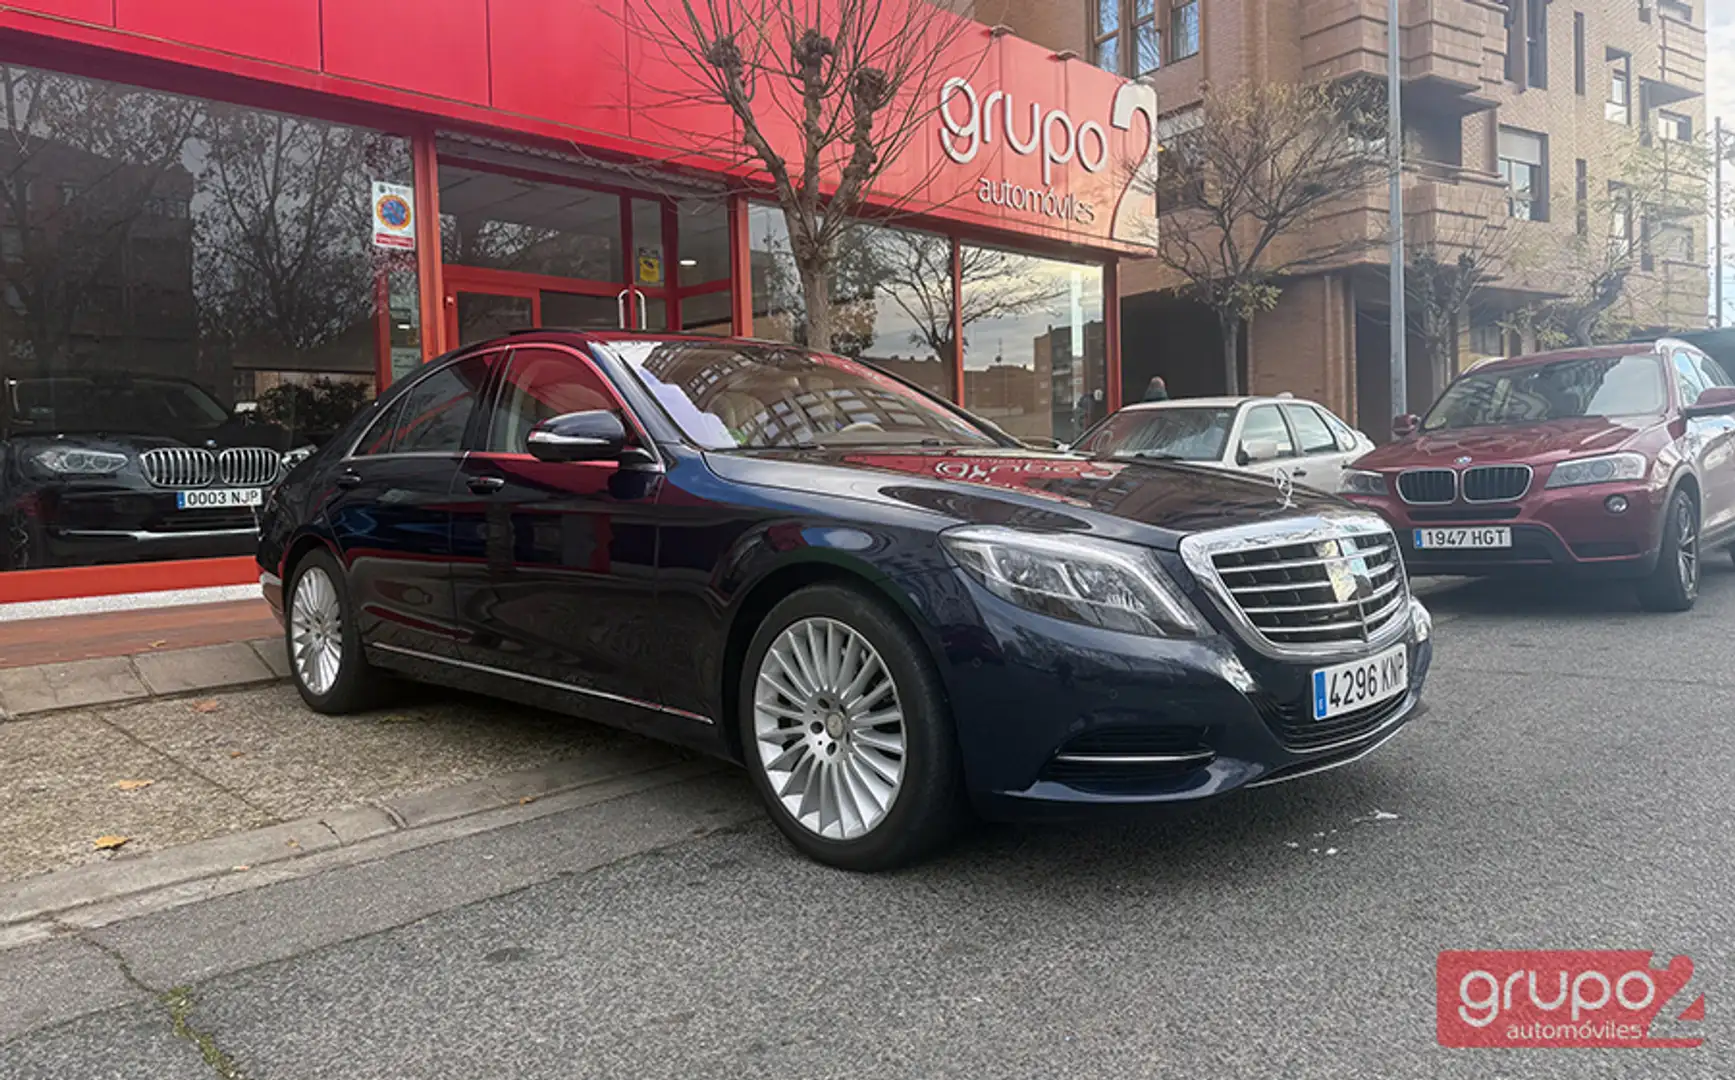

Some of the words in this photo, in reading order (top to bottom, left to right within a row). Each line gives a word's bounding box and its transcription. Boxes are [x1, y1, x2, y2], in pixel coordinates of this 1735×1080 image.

[940, 77, 1108, 185] grupo
[978, 177, 1095, 225] automóviles
[187, 491, 226, 506] 0003
[231, 489, 259, 504] NJP
[1427, 530, 1467, 546] 1947
[1472, 528, 1505, 546] HGT
[1330, 663, 1378, 709] 4296
[1382, 651, 1405, 693] KNP
